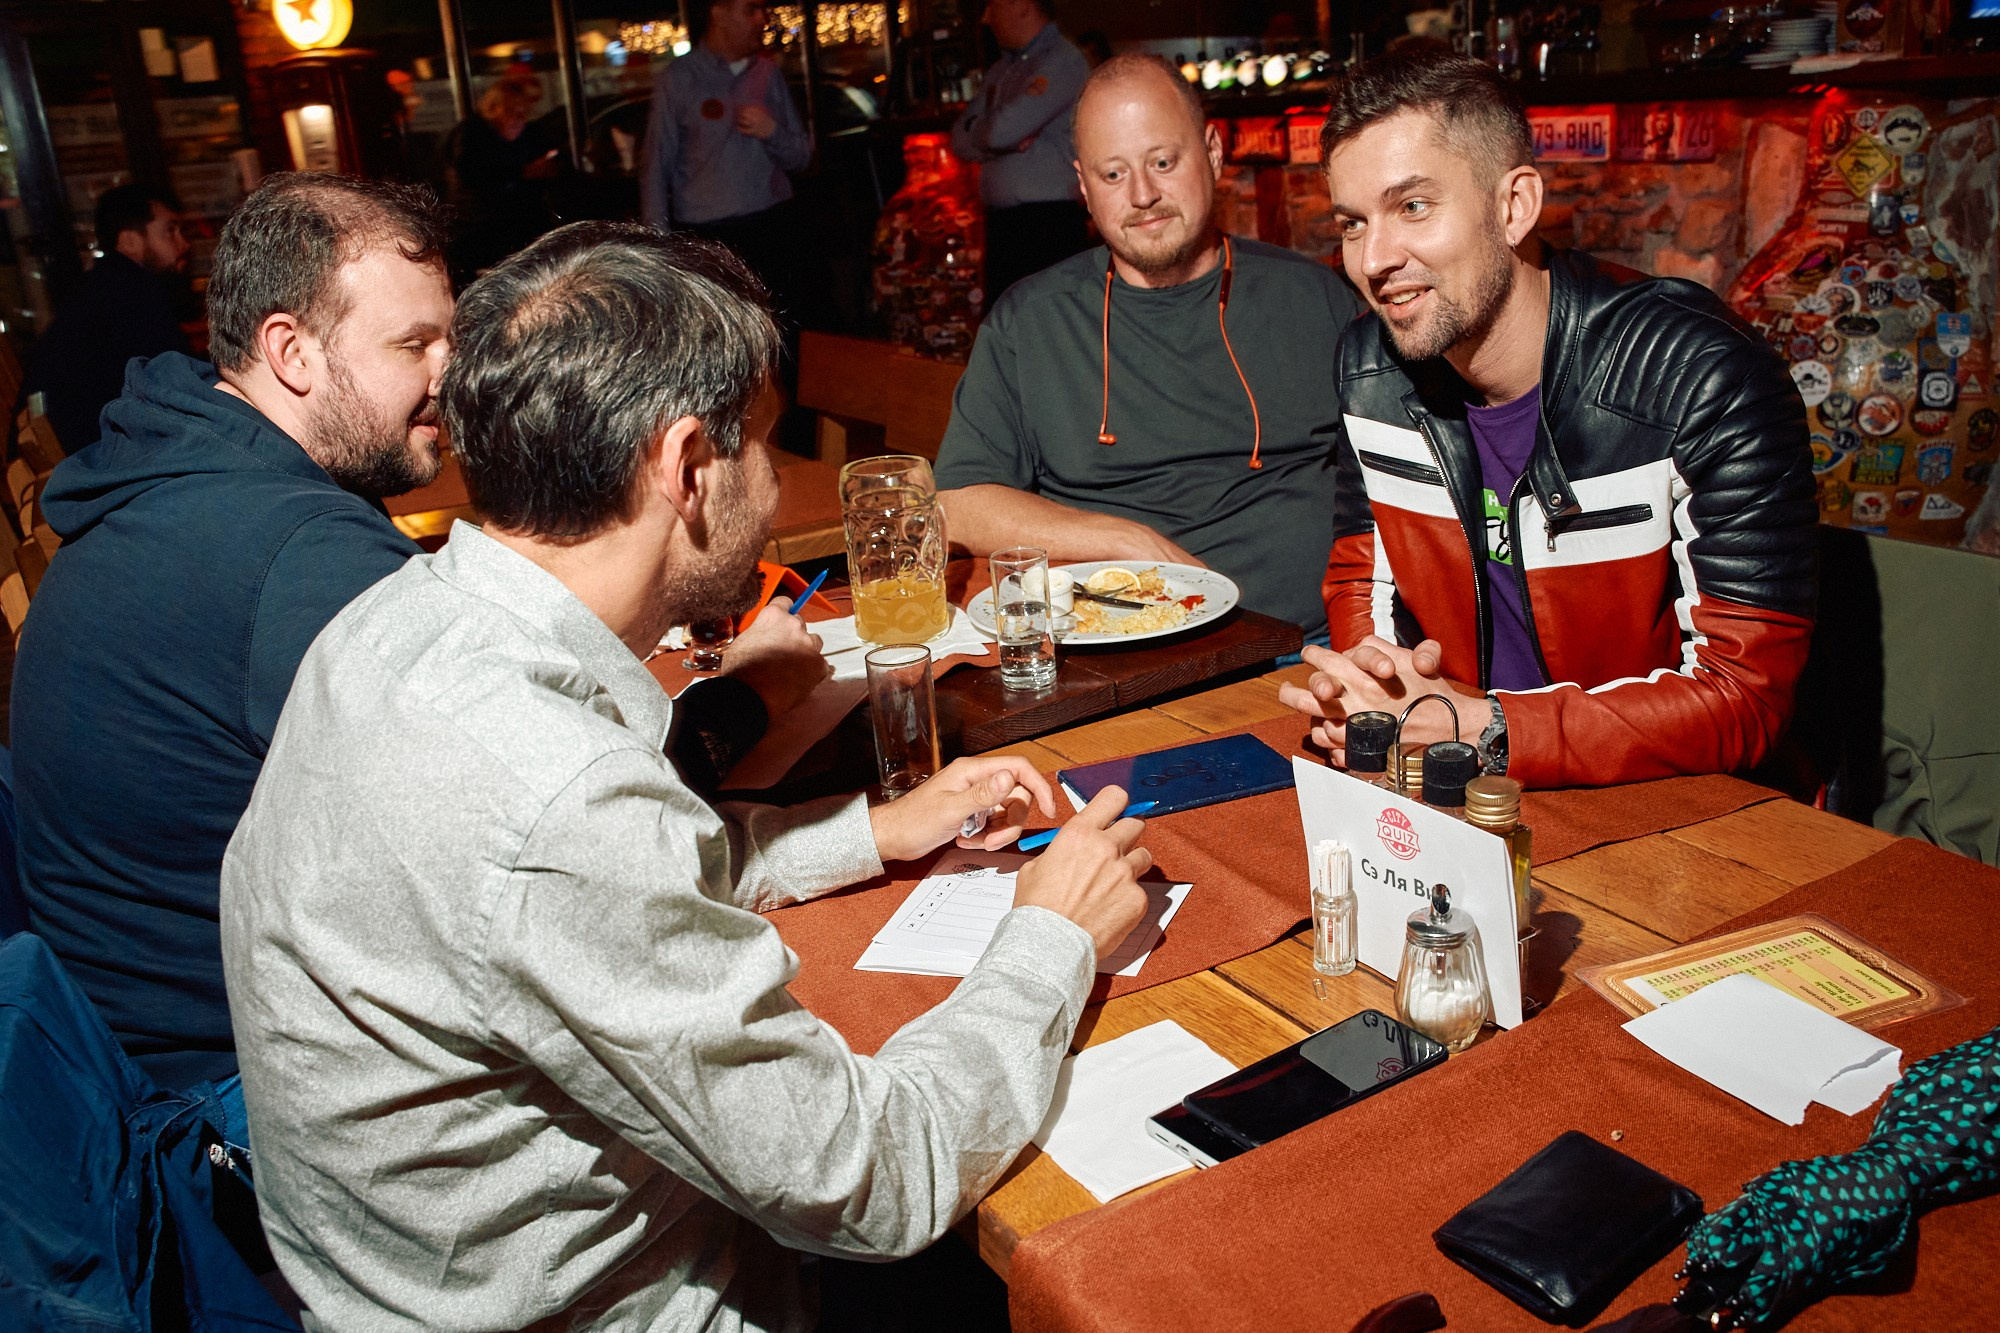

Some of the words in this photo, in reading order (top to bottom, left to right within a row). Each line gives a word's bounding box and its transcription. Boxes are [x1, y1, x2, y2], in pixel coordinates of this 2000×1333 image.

[1386, 810, 1408, 827] CITY
[1382, 825, 1415, 846] QUIZ
[1361, 858, 1379, 880] Сэ
[1383, 868, 1408, 892] Ля
